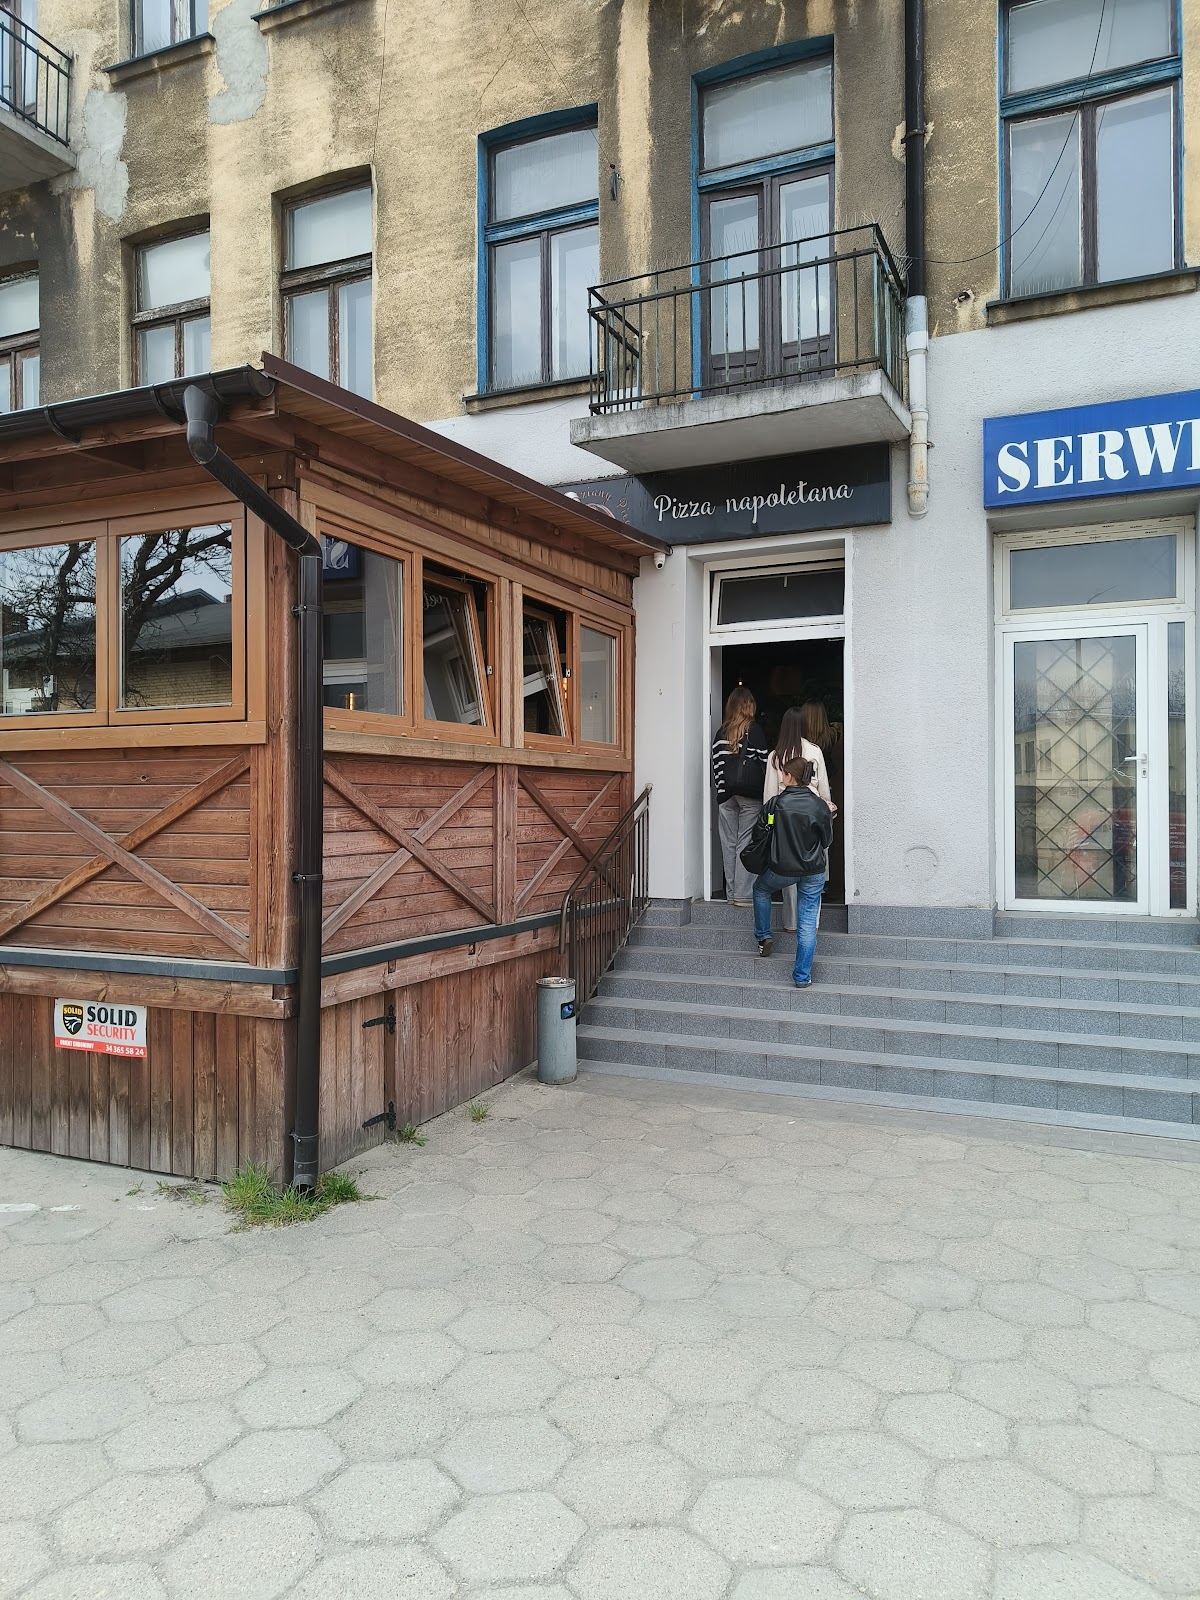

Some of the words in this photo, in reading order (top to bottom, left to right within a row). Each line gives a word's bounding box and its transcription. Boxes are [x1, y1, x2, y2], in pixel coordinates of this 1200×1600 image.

[653, 494, 716, 522] Pizza
[725, 480, 854, 524] napoletana
[63, 1007, 82, 1015] SOLID
[87, 1006, 137, 1027] SOLID
[86, 1023, 137, 1041] SECURITY
[105, 1044, 113, 1052] 34
[113, 1045, 124, 1054] 365
[125, 1047, 134, 1055] 58
[135, 1048, 144, 1056] 24
